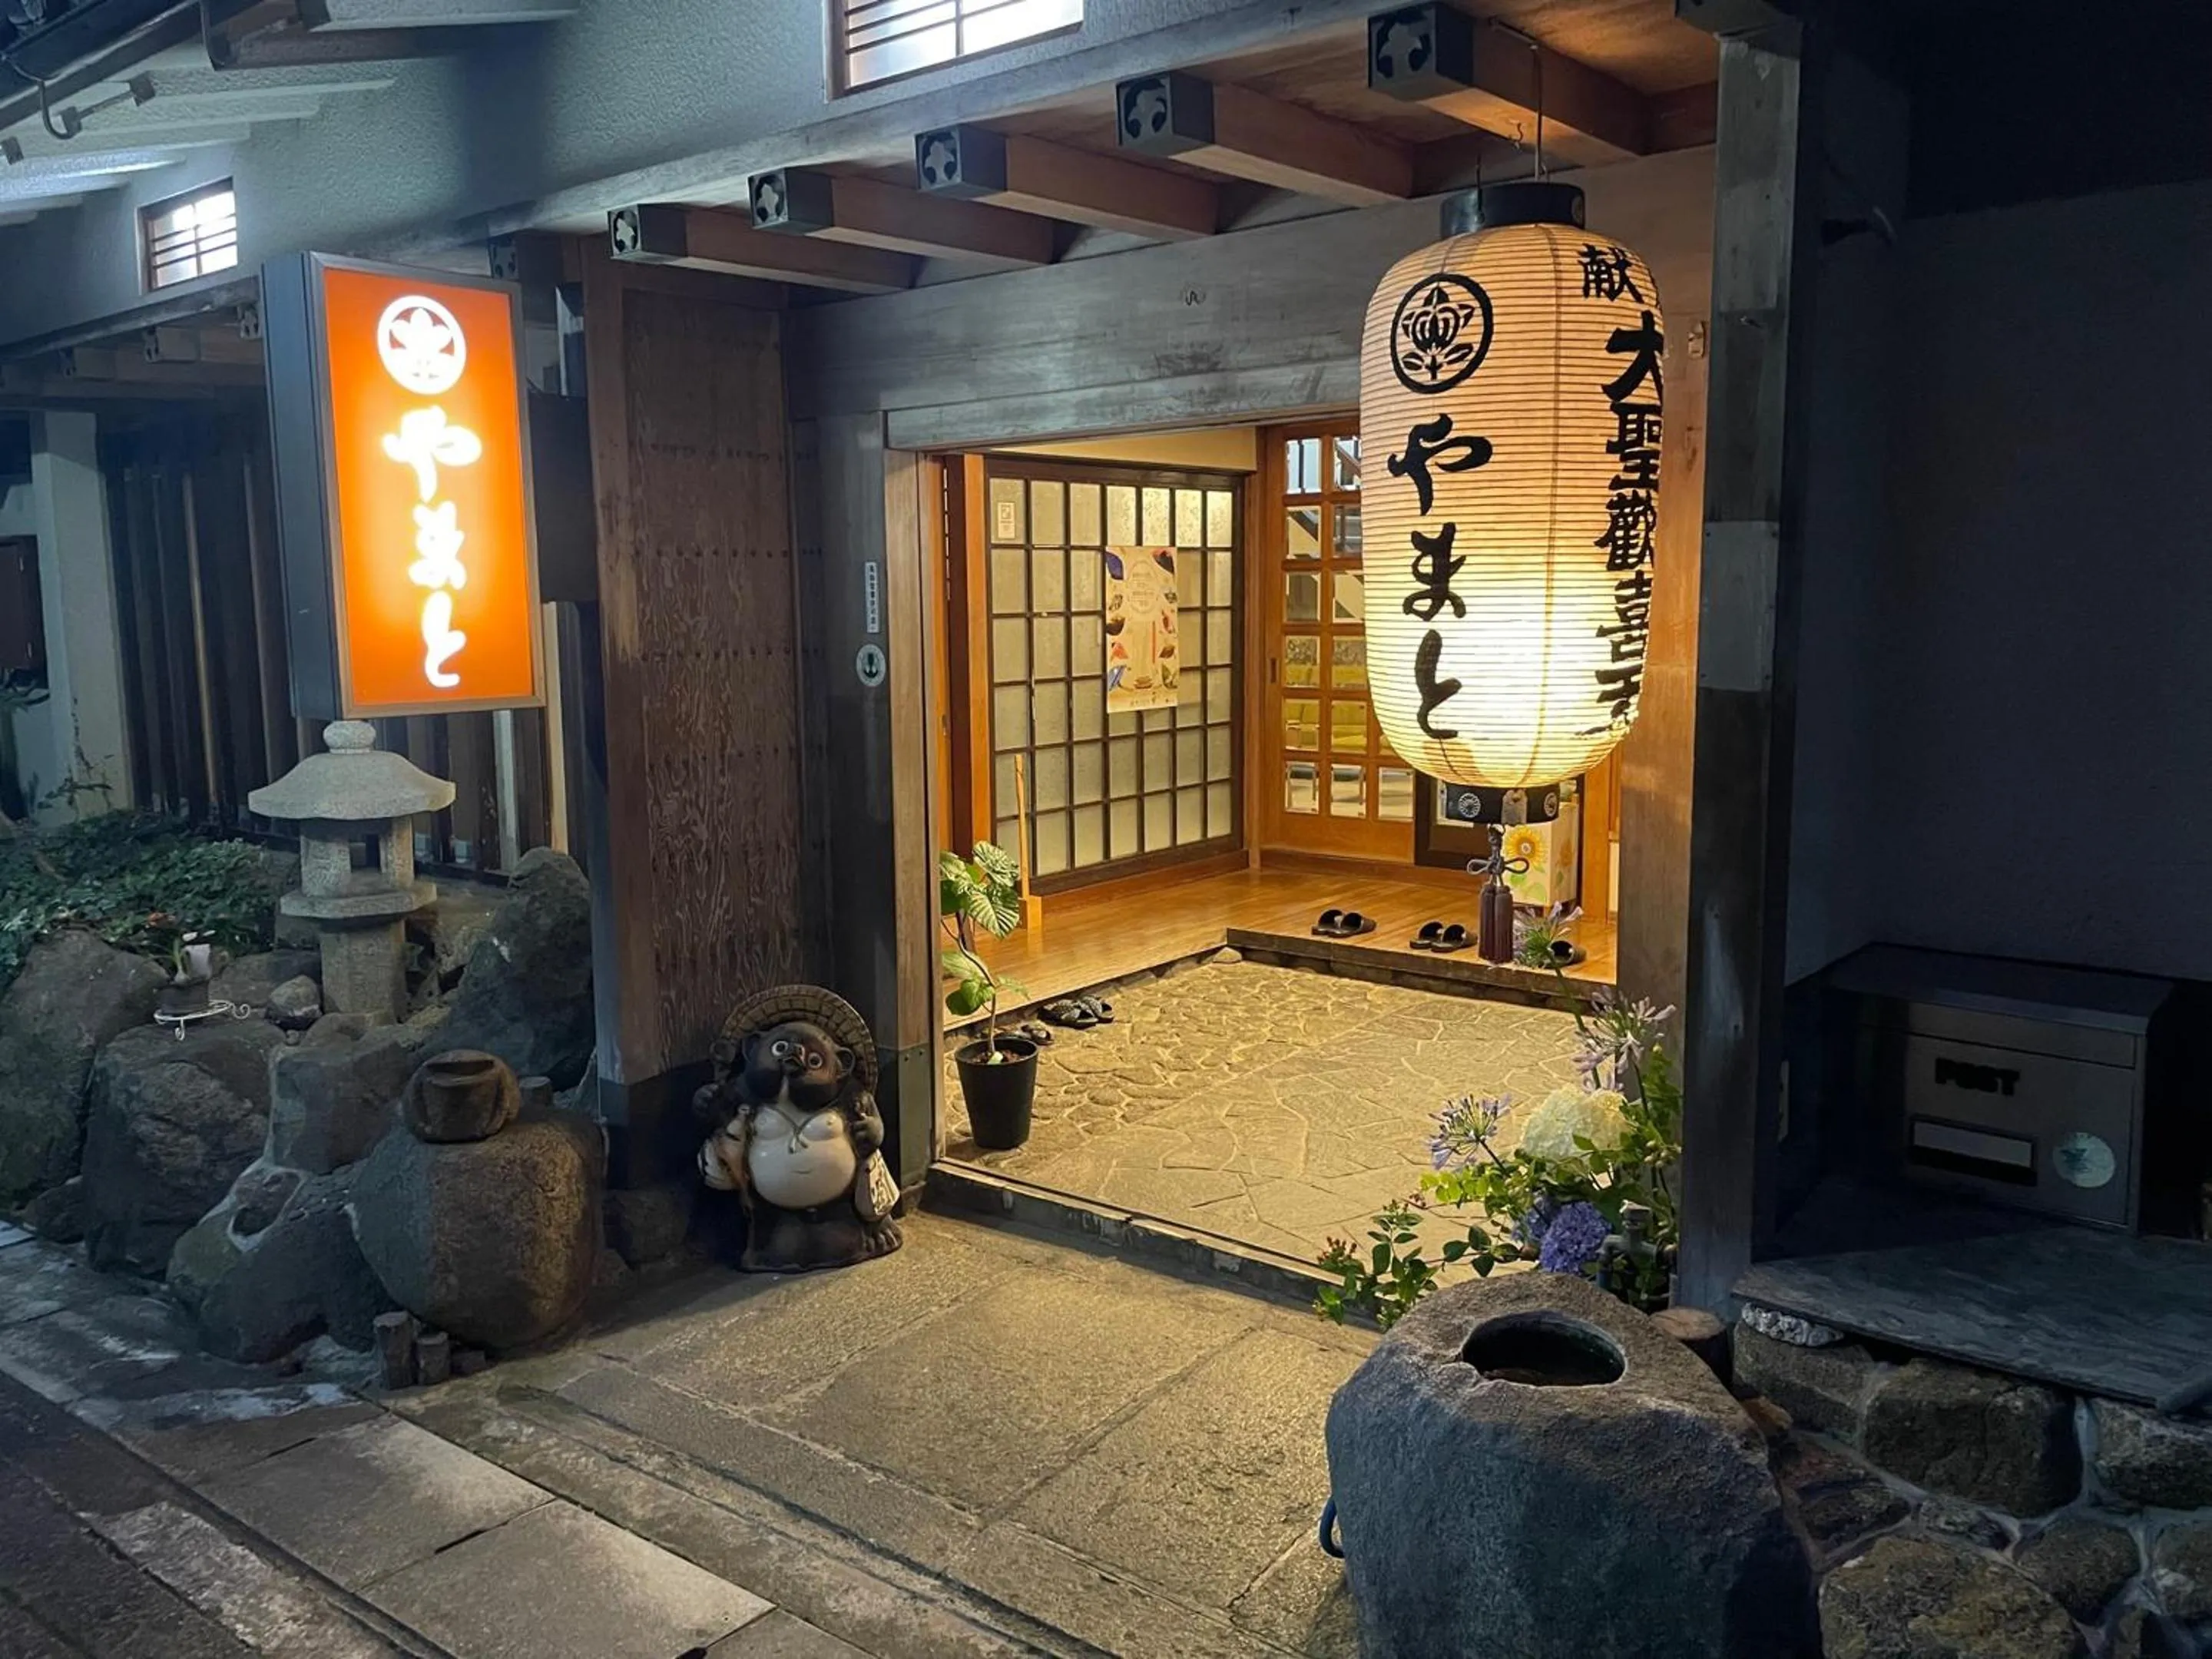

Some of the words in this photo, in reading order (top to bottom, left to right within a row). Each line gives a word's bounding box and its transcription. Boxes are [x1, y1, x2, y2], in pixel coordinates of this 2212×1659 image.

[383, 405, 482, 687] やまと
[1387, 413, 1492, 740] やまと
[1935, 1057, 2021, 1096] POST
